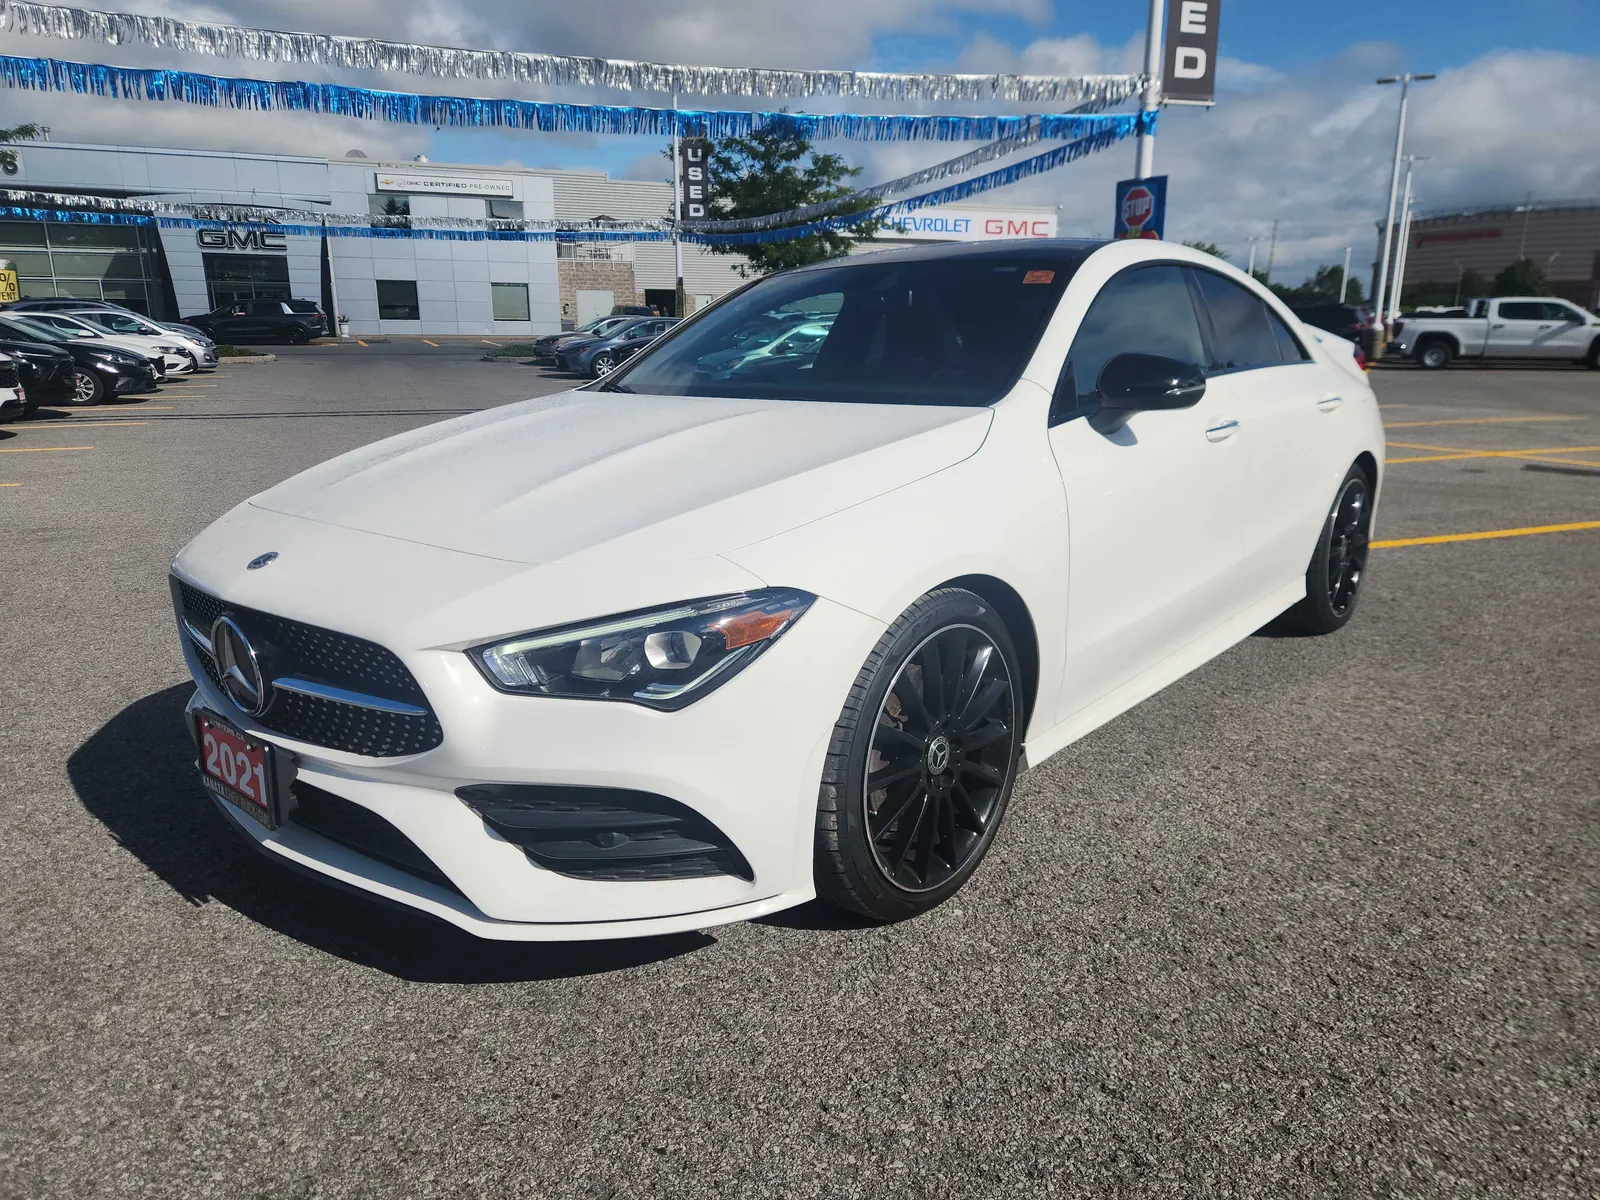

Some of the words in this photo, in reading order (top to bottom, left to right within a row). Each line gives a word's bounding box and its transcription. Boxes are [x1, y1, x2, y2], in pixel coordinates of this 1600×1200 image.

[423, 181, 467, 189] CERTIFIED
[469, 183, 510, 191] PRE-OWNED
[687, 148, 705, 217] USED
[1121, 196, 1151, 218] STOP
[985, 219, 1049, 236] GMC
[196, 229, 288, 251] GMC
[203, 733, 268, 806] 2021
[202, 774, 225, 796] KANATA
